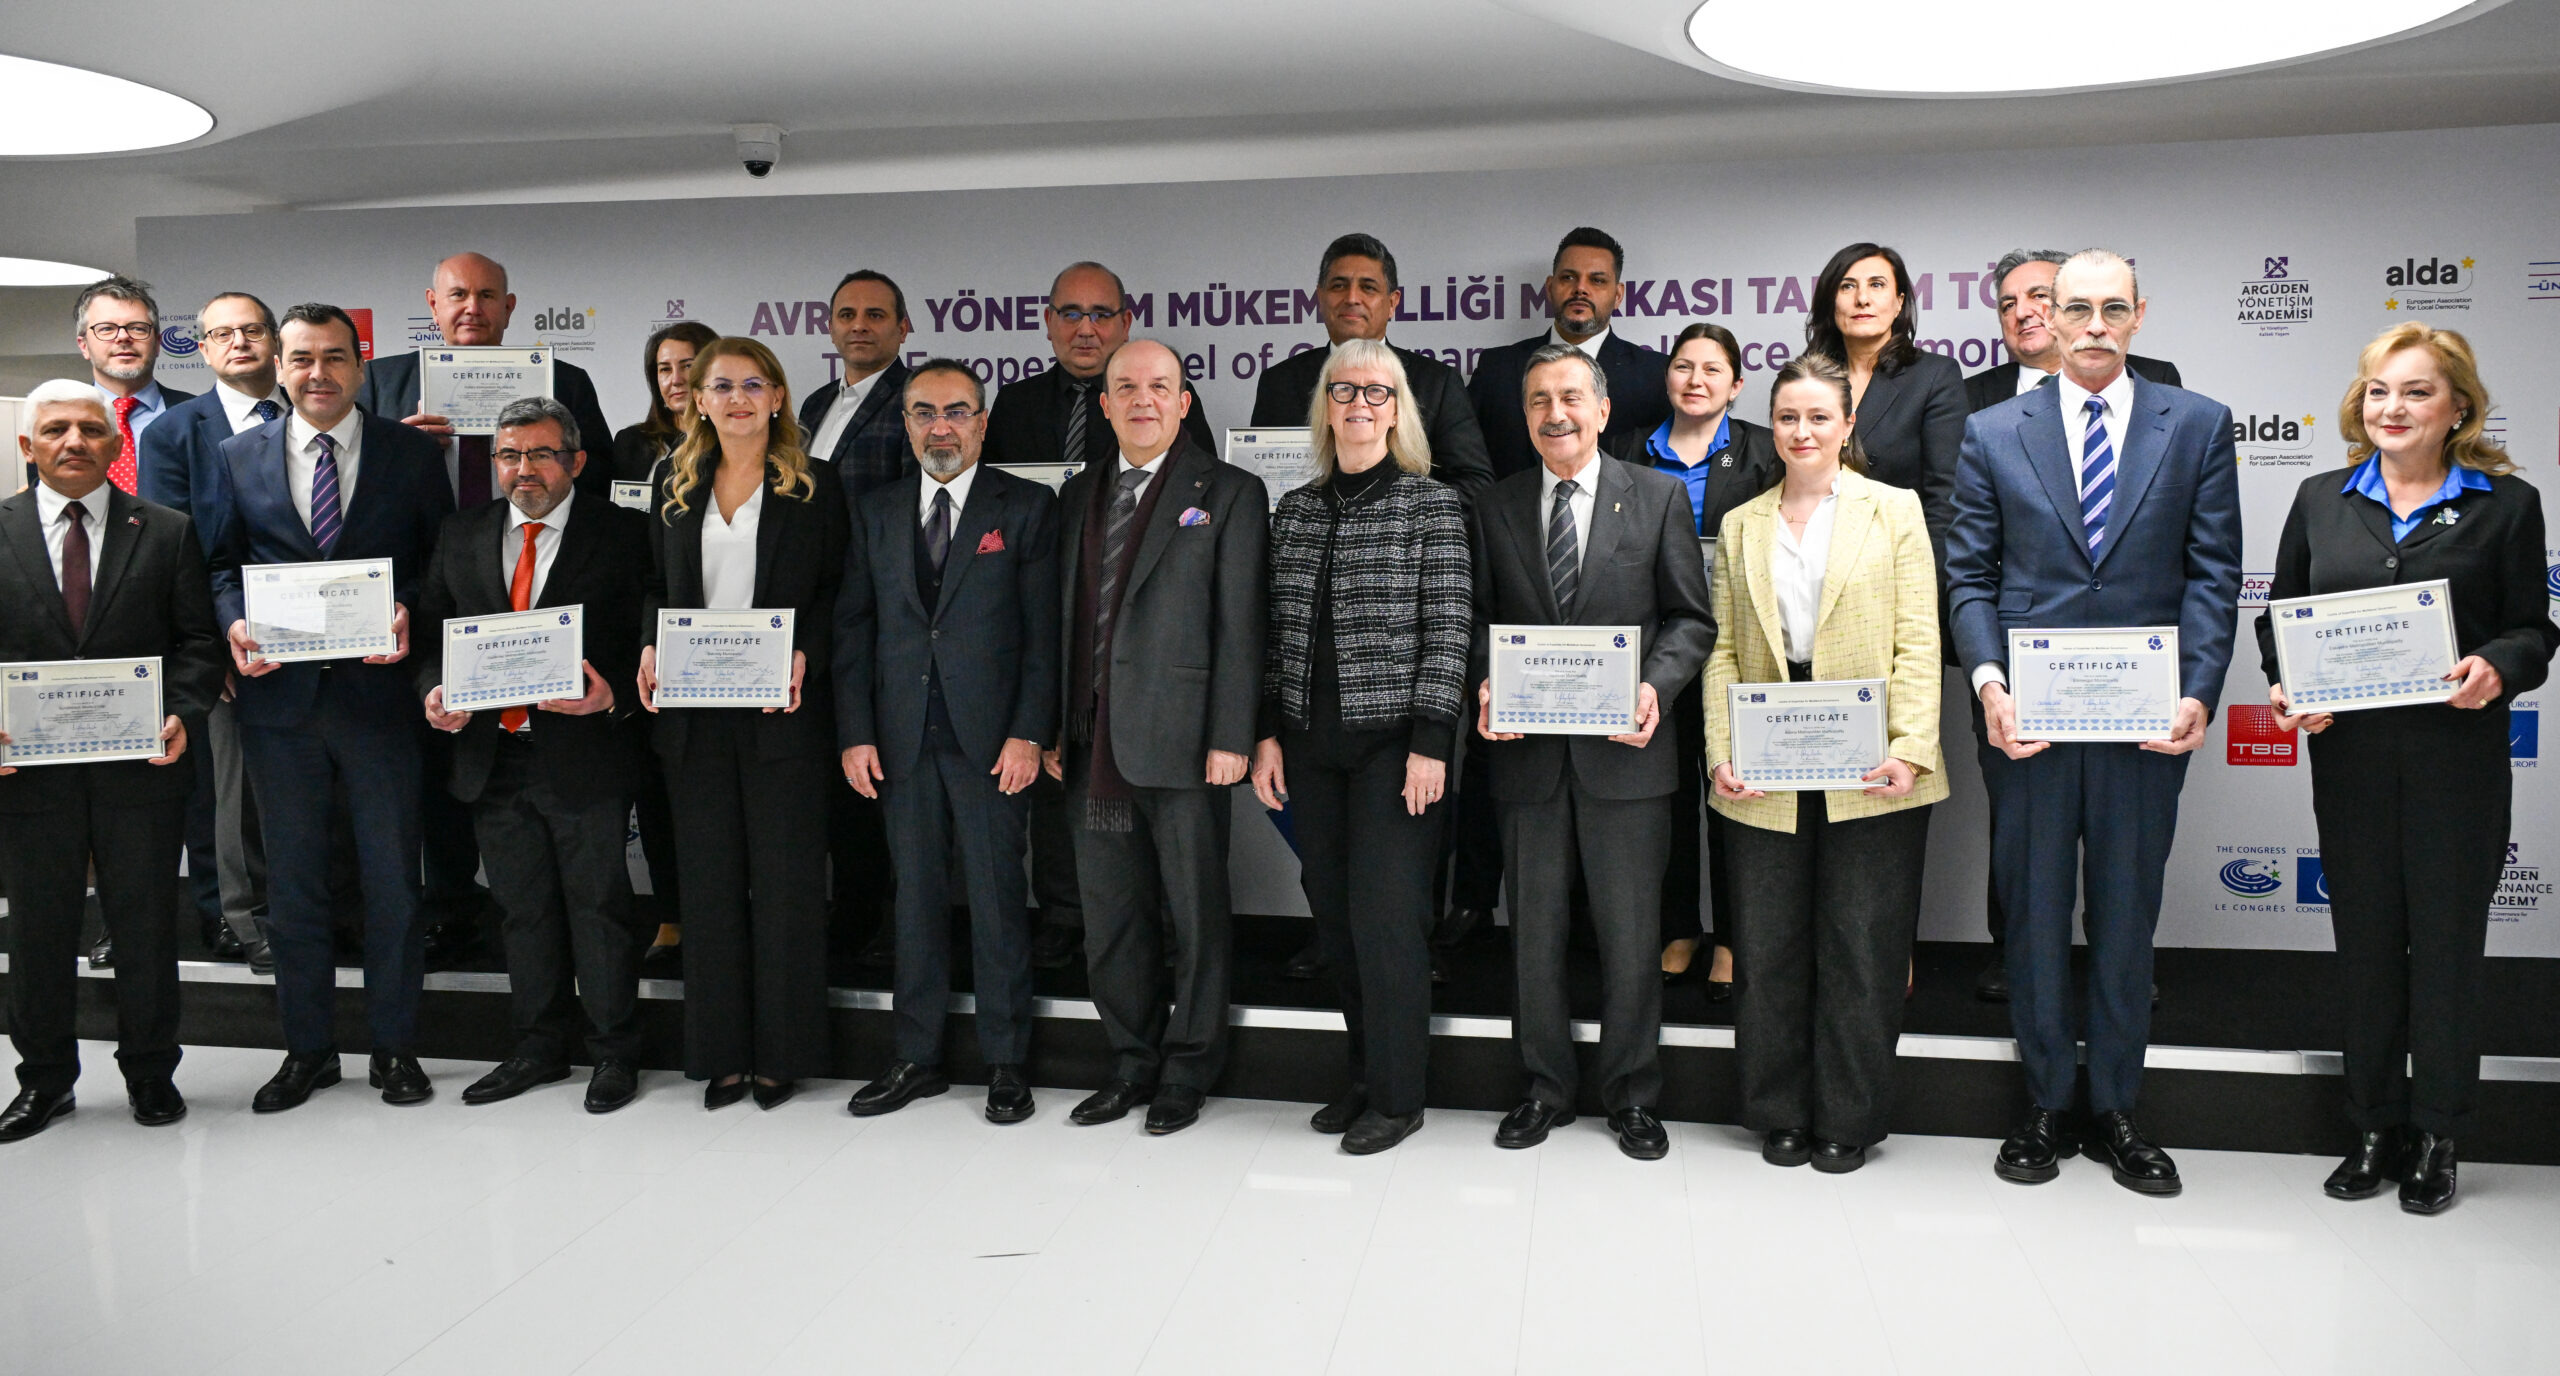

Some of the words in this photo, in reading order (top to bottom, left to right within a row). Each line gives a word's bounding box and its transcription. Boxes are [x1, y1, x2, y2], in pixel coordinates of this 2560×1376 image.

[2385, 257, 2458, 287] alda
[2241, 283, 2309, 296] ARGÜDEN
[1168, 274, 1505, 328] MÜKEMLLİĞİ
[1520, 279, 1732, 320] MKASI
[2237, 294, 2313, 310] YÖNETİŞİM
[534, 306, 585, 331] alda
[2237, 307, 2313, 320] AKADEMİSİ
[169, 361, 205, 370] CONGRÈS
[1231, 342, 1274, 379] of
[452, 372, 523, 380] CERTIFICATE
[2233, 414, 2299, 443] alda
[1254, 452, 1314, 460] CERTIFICA
[2315, 620, 2410, 639] CERTIFICATE
[477, 635, 551, 651] CERTIFICATE
[689, 637, 761, 645] CERTIFICATE
[1524, 657, 1604, 666] CERTIFICATE
[2049, 661, 2138, 670] CERTIFICATE
[38, 688, 126, 700] CERTIFICATE
[1766, 713, 1849, 723] CERTIFICATE
[2232, 743, 2293, 755] TBB
[2511, 760, 2538, 768] UROPE
[2216, 845, 2234, 854] THE
[2236, 846, 2287, 855] CONGRESS
[2496, 883, 2553, 894] RNANCE
[2490, 895, 2539, 906] ADEMY
[2214, 903, 2227, 911] LE
[2232, 902, 2287, 913] CONGRÈS
[2295, 905, 2332, 914] CONSEIL
